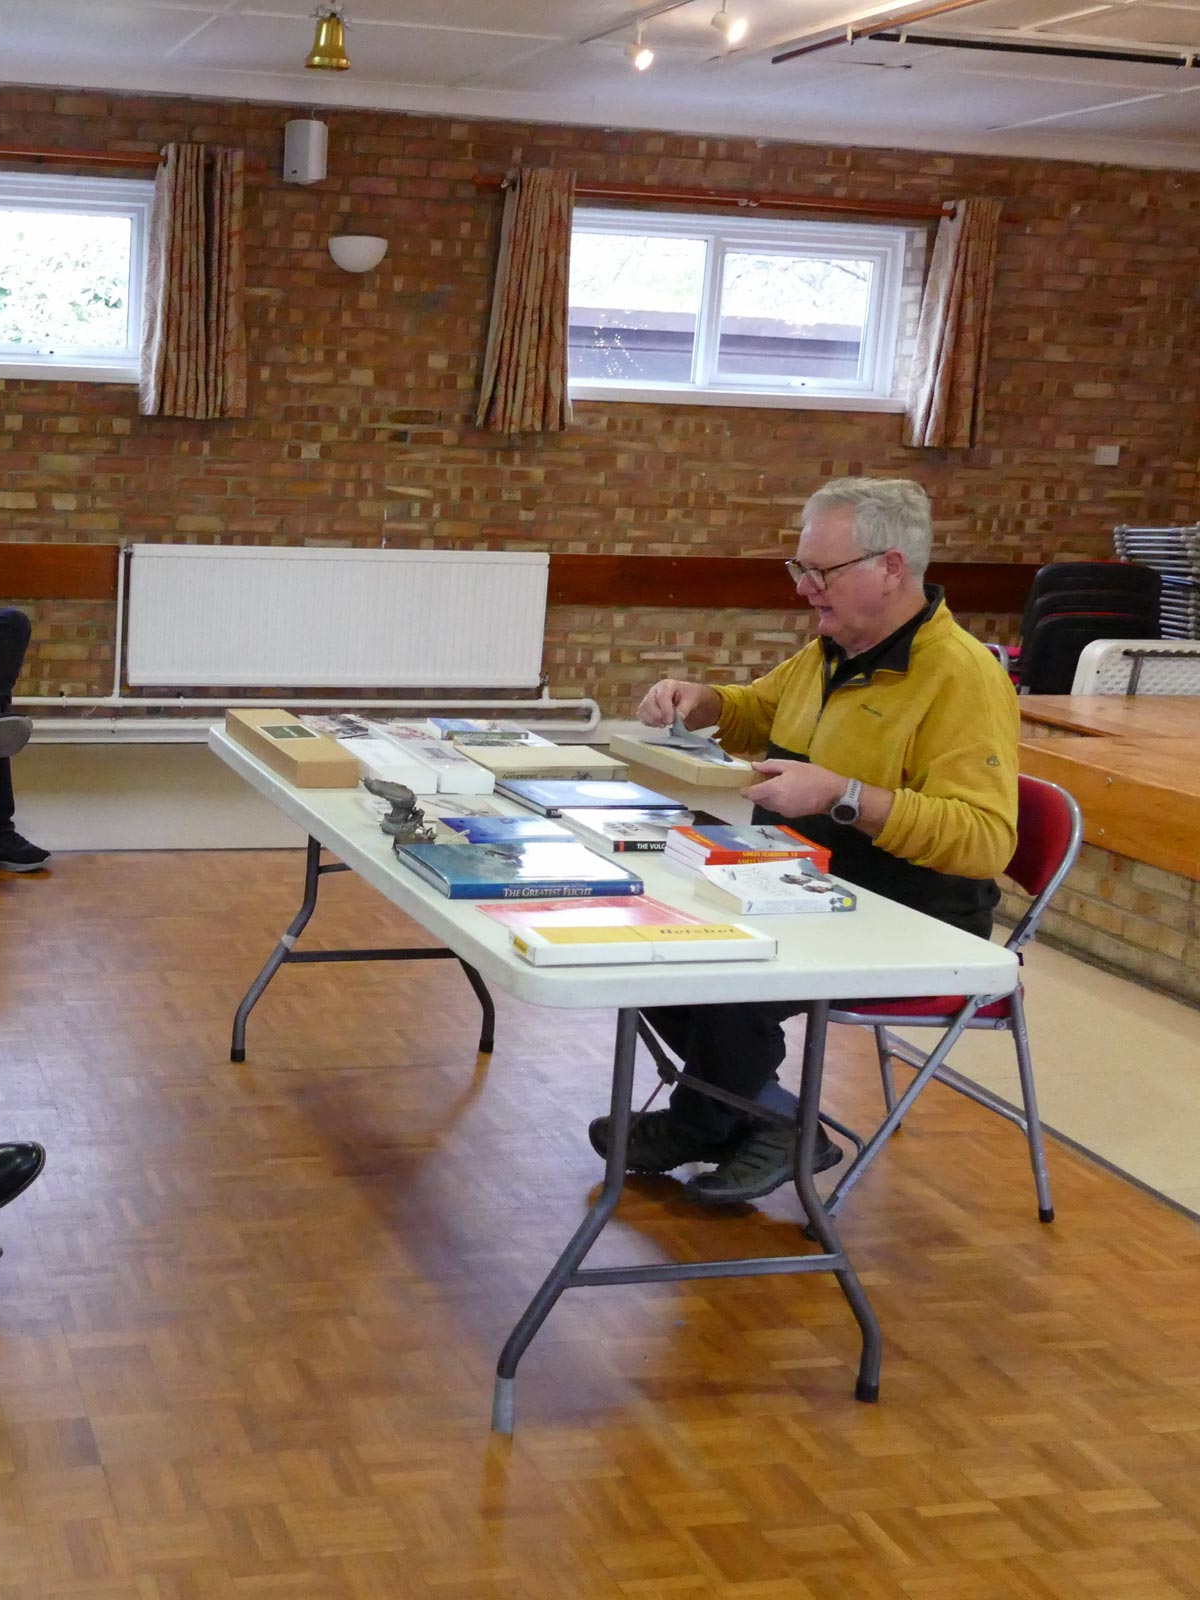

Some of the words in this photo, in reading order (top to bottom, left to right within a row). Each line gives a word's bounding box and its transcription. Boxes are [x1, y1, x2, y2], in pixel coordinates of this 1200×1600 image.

[503, 887, 521, 898] THE
[521, 887, 562, 897] GREATEST
[562, 886, 593, 896] FLIGHT
